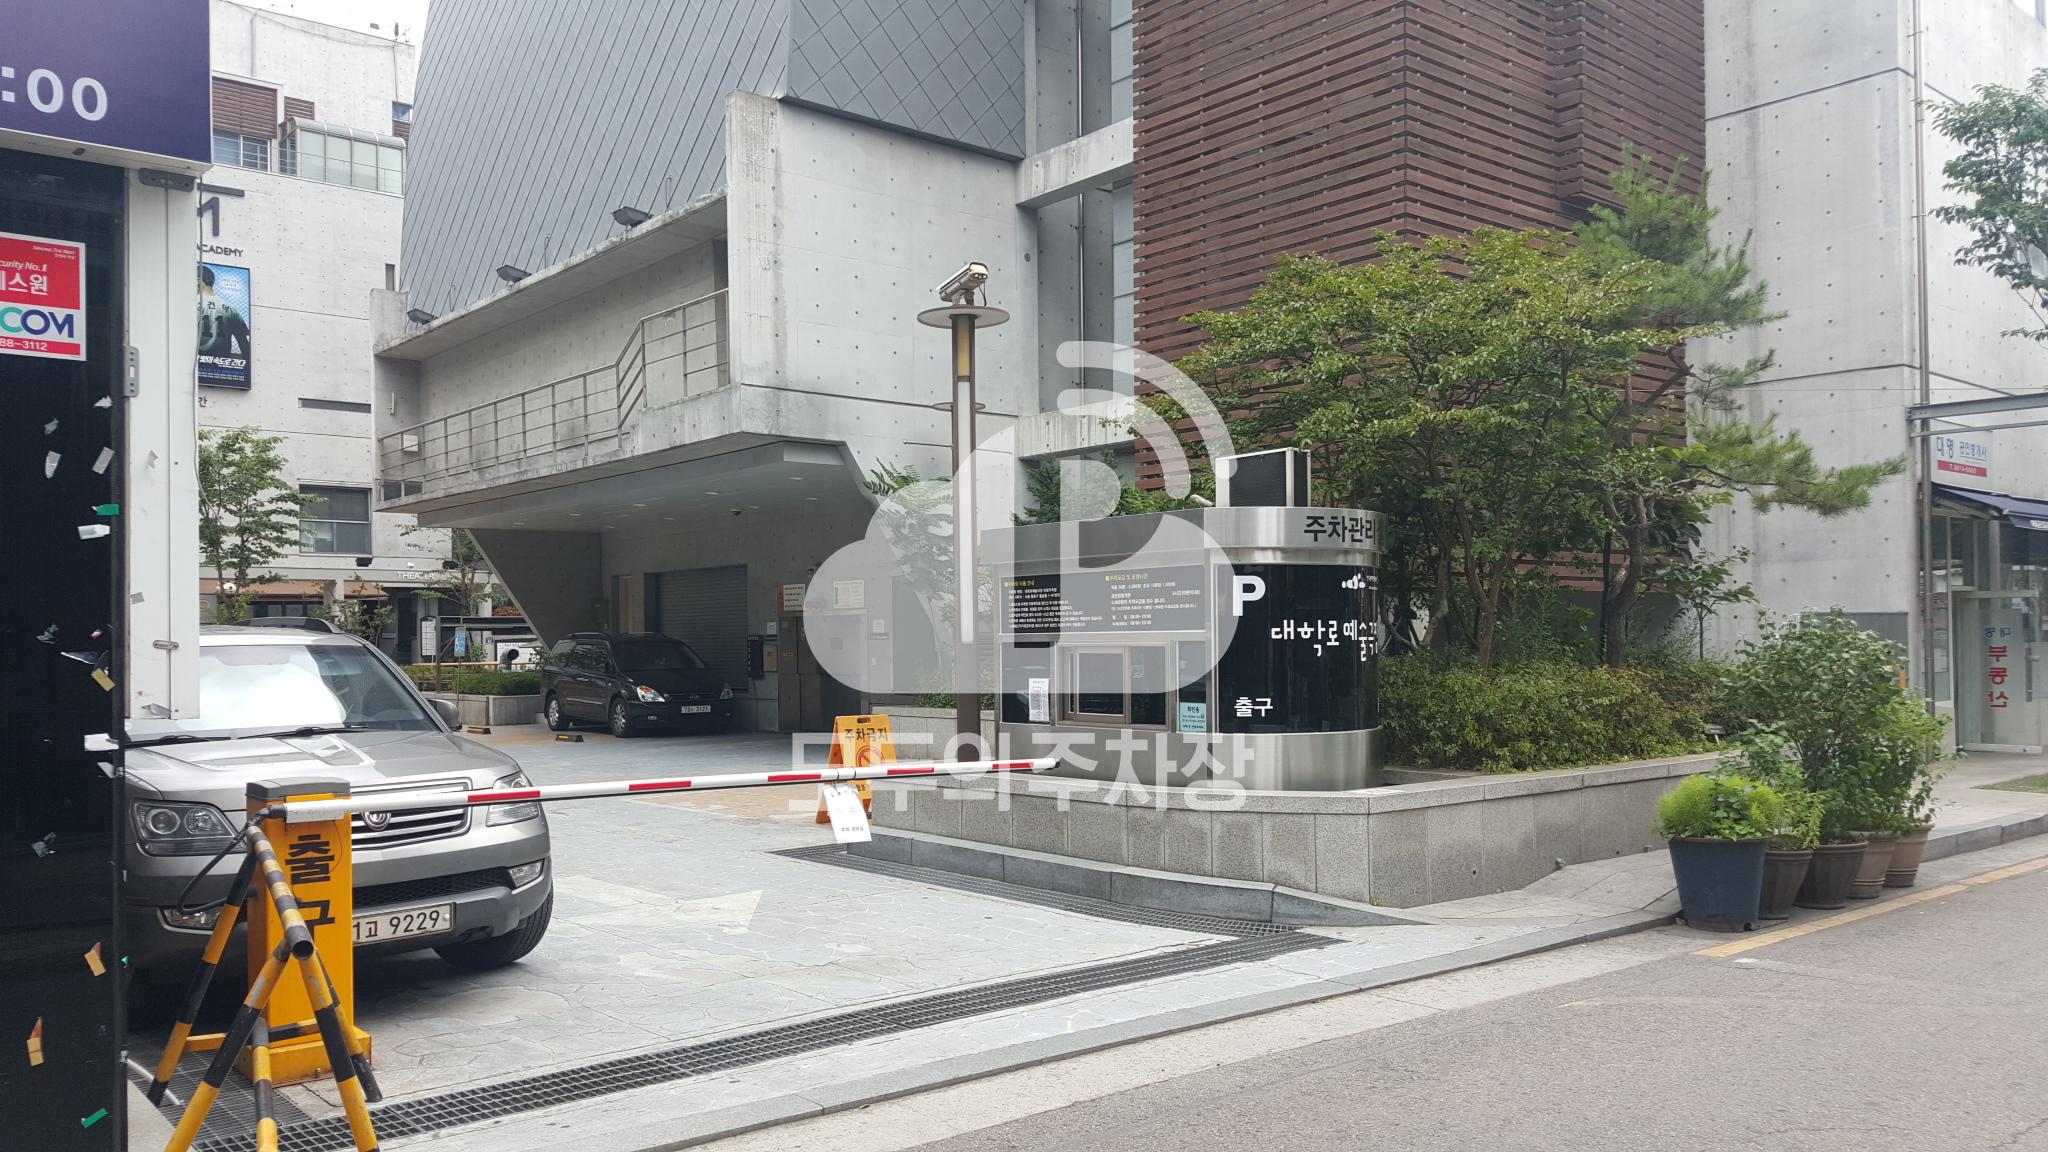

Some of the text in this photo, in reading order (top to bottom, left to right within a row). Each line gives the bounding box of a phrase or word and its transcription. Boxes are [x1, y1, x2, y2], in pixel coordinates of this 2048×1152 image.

[1303, 515, 1377, 545] 주차관리
[397, 572, 434, 580] THEAER
[1232, 575, 1266, 617] P
[1234, 696, 1274, 717] 출구
[844, 727, 888, 743] 주차금지
[285, 834, 335, 944] 출구
[389, 909, 440, 935] 9229
